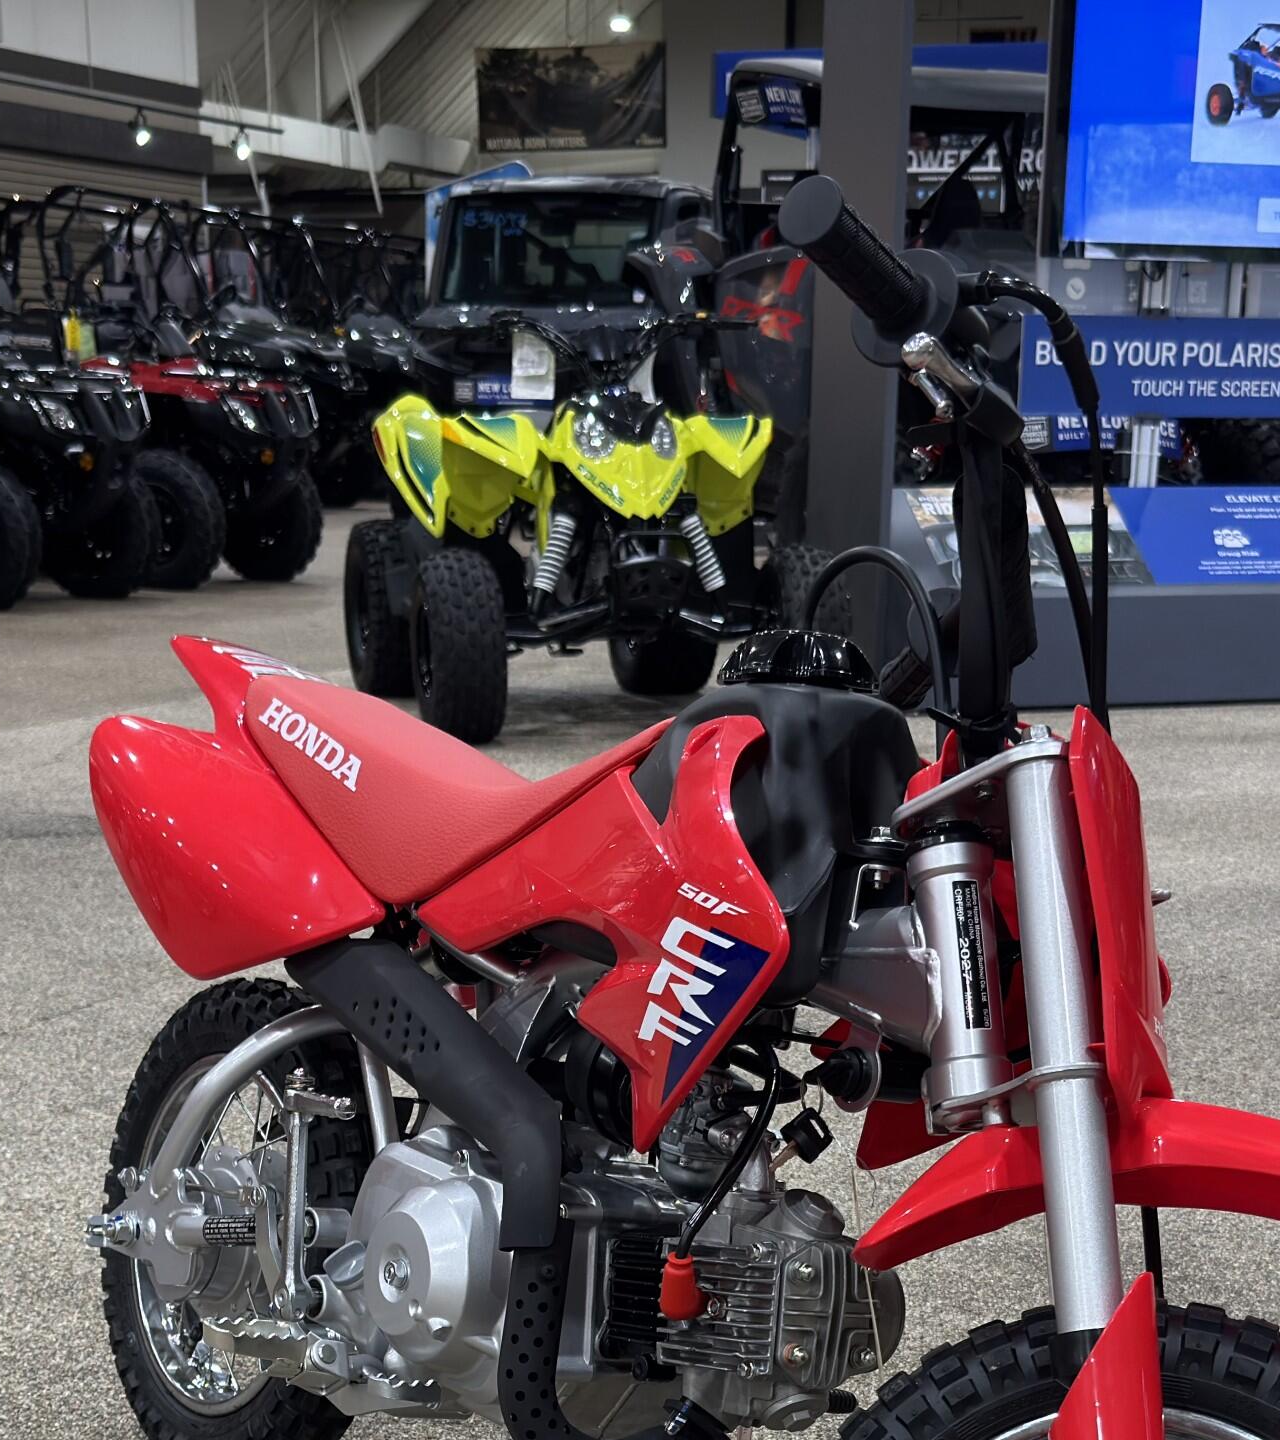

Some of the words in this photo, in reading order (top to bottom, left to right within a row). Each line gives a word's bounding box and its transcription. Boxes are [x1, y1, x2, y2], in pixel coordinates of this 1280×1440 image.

[1113, 341, 1177, 367] YOUR
[1131, 379, 1185, 397] TOUCH
[1187, 380, 1218, 397] THE
[1220, 380, 1280, 397] SCREEN
[1058, 432, 1085, 440] BUILT
[577, 464, 625, 507] POLARIS
[1224, 494, 1272, 504] ELEVATE
[258, 697, 362, 792] HONDA
[677, 881, 750, 916] 50F
[967, 910, 973, 918] IN
[974, 924, 982, 955] Motorcycle
[637, 916, 736, 1047] CRF
